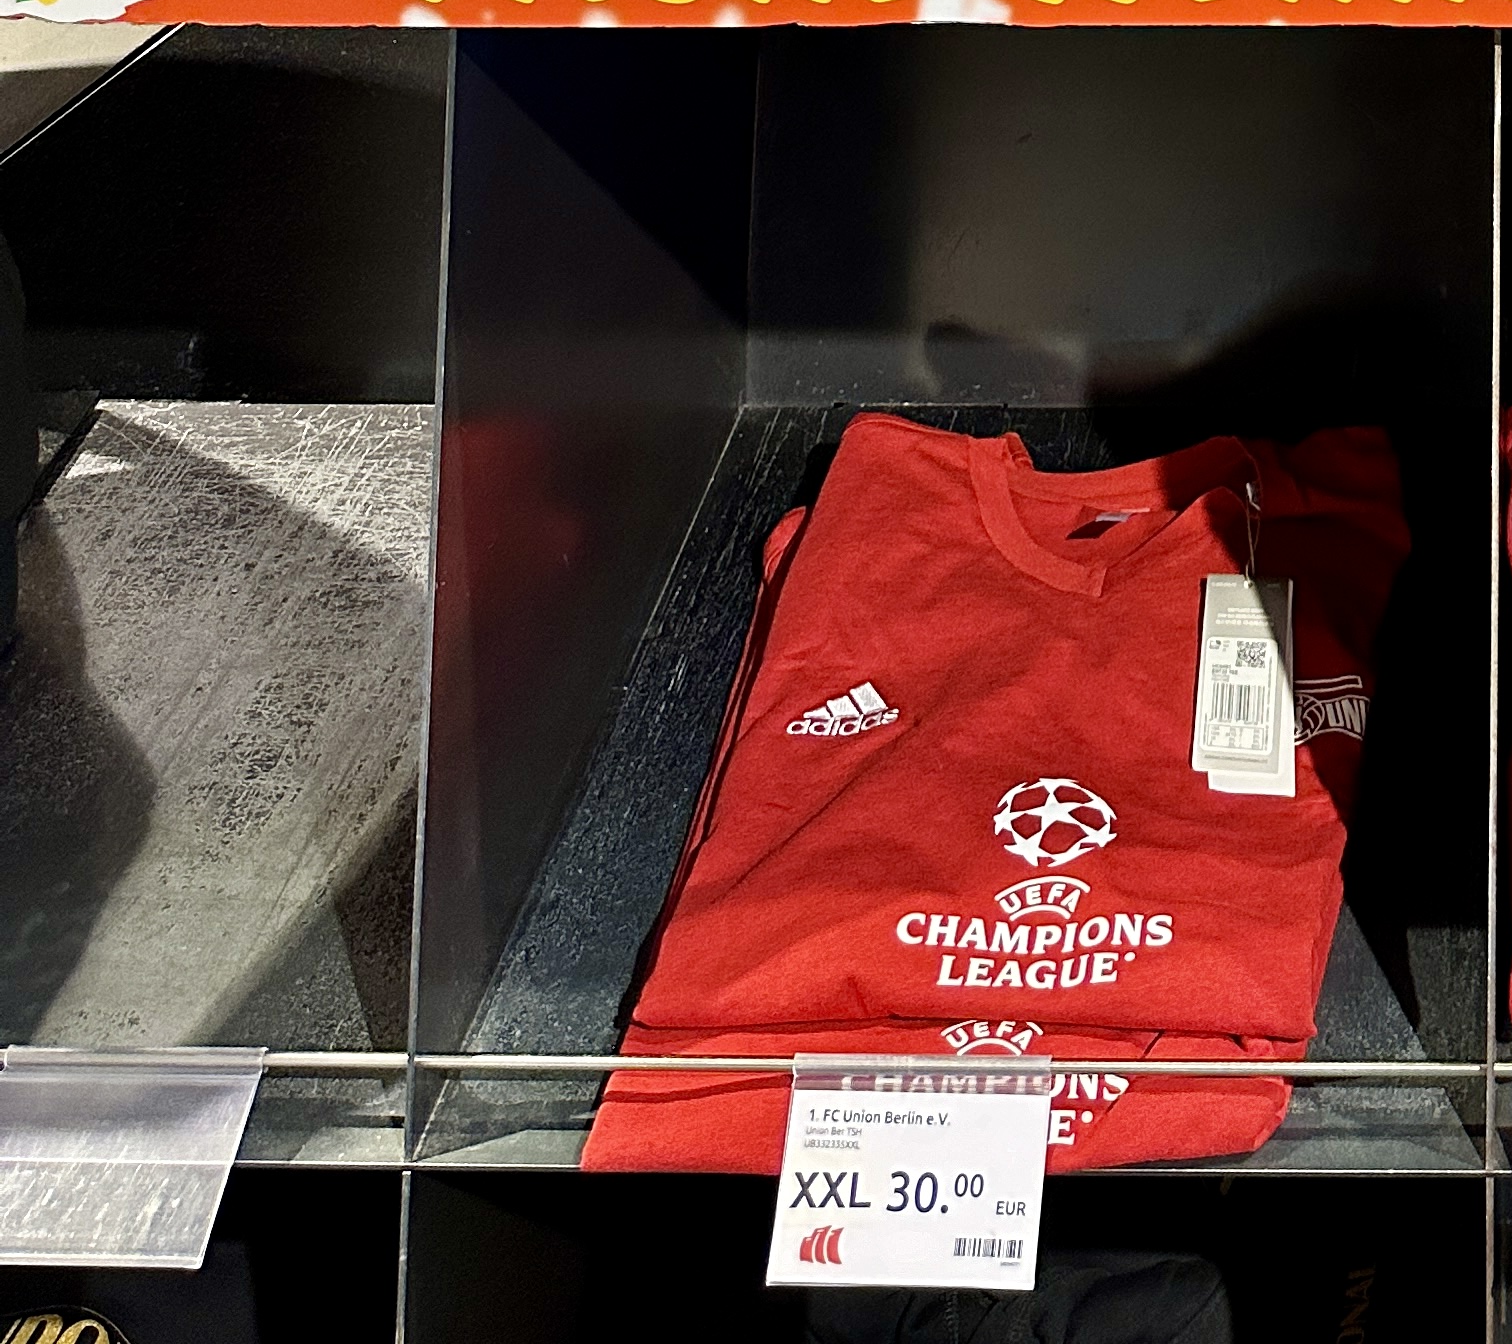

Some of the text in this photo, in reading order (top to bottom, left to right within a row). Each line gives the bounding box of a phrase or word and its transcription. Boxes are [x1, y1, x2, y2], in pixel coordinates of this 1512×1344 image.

[786, 706, 900, 737] adidas
[1326, 697, 1368, 734] UNI
[998, 882, 1082, 915] UEFA
[896, 913, 1173, 957] CHAMPIONS
[936, 952, 1120, 991] LEAGUE
[943, 1020, 1035, 1051] UEFA
[806, 1126, 829, 1136] Union
[847, 1127, 862, 1136] TSH
[823, 1109, 840, 1122] FC
[843, 1110, 881, 1123] Union
[884, 1111, 924, 1124] Berlin
[789, 1171, 1026, 1216] XXL 30.00 EUR
